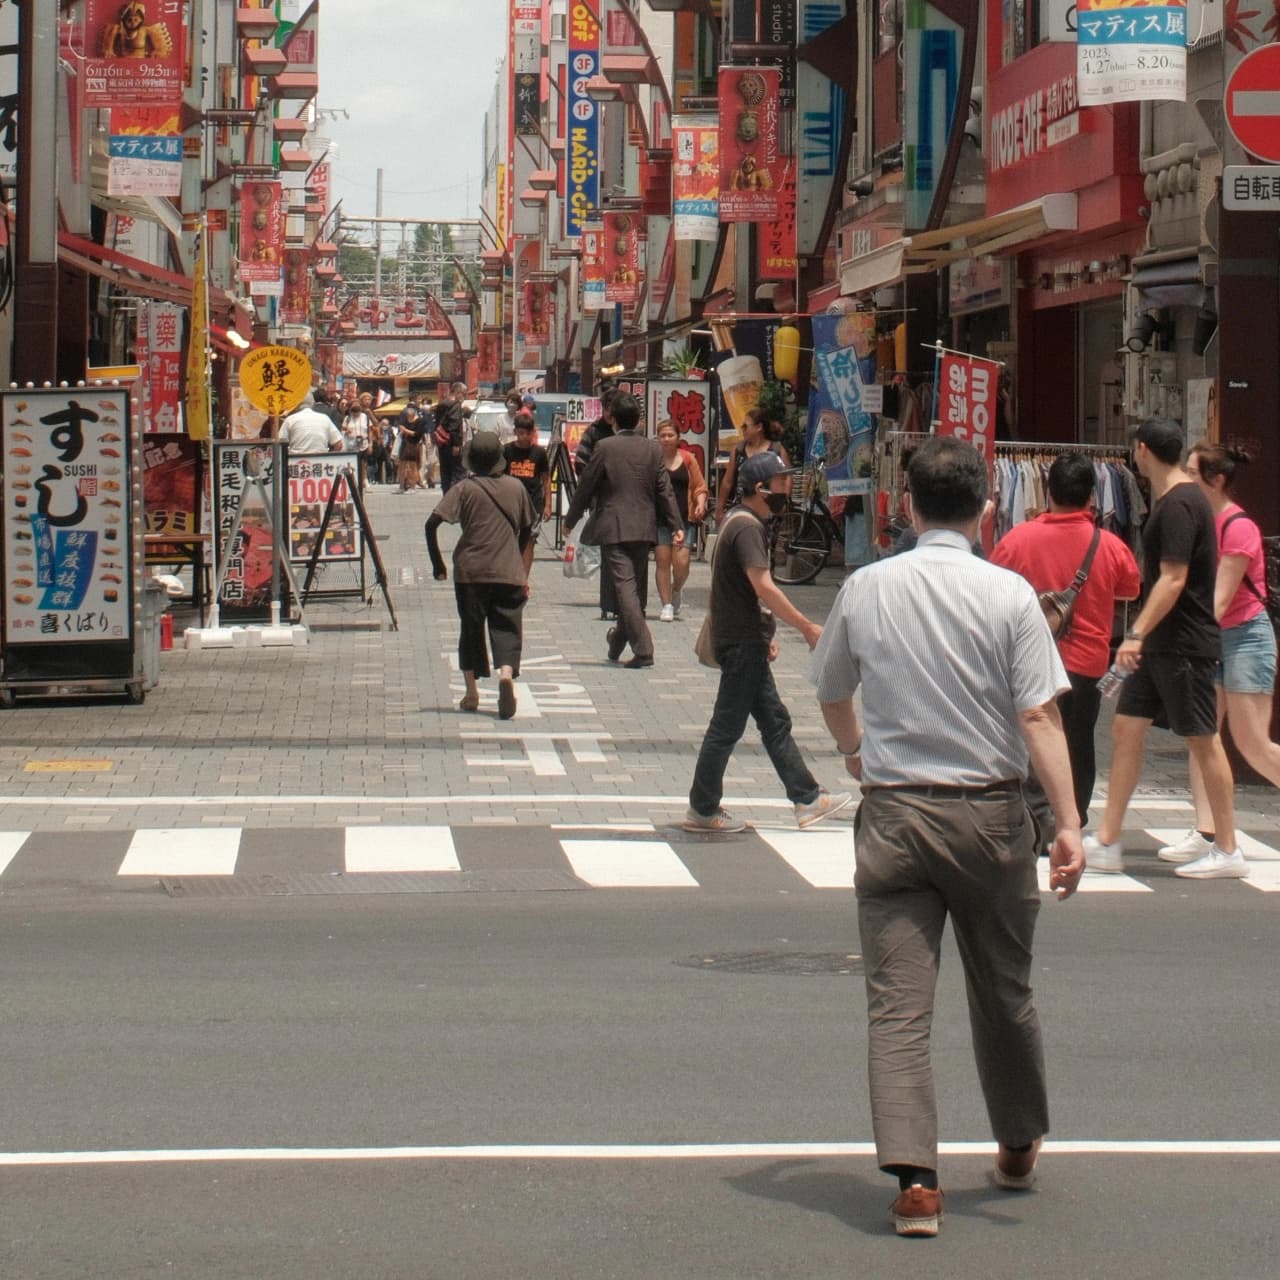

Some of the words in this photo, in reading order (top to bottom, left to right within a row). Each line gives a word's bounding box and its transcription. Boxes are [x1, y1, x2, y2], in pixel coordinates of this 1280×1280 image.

[1080, 11, 1186, 39] マティス展
[576, 58, 591, 71] 3F
[577, 103, 591, 117] 1F
[111, 138, 179, 157] マティス展
[33, 399, 100, 528] すし
